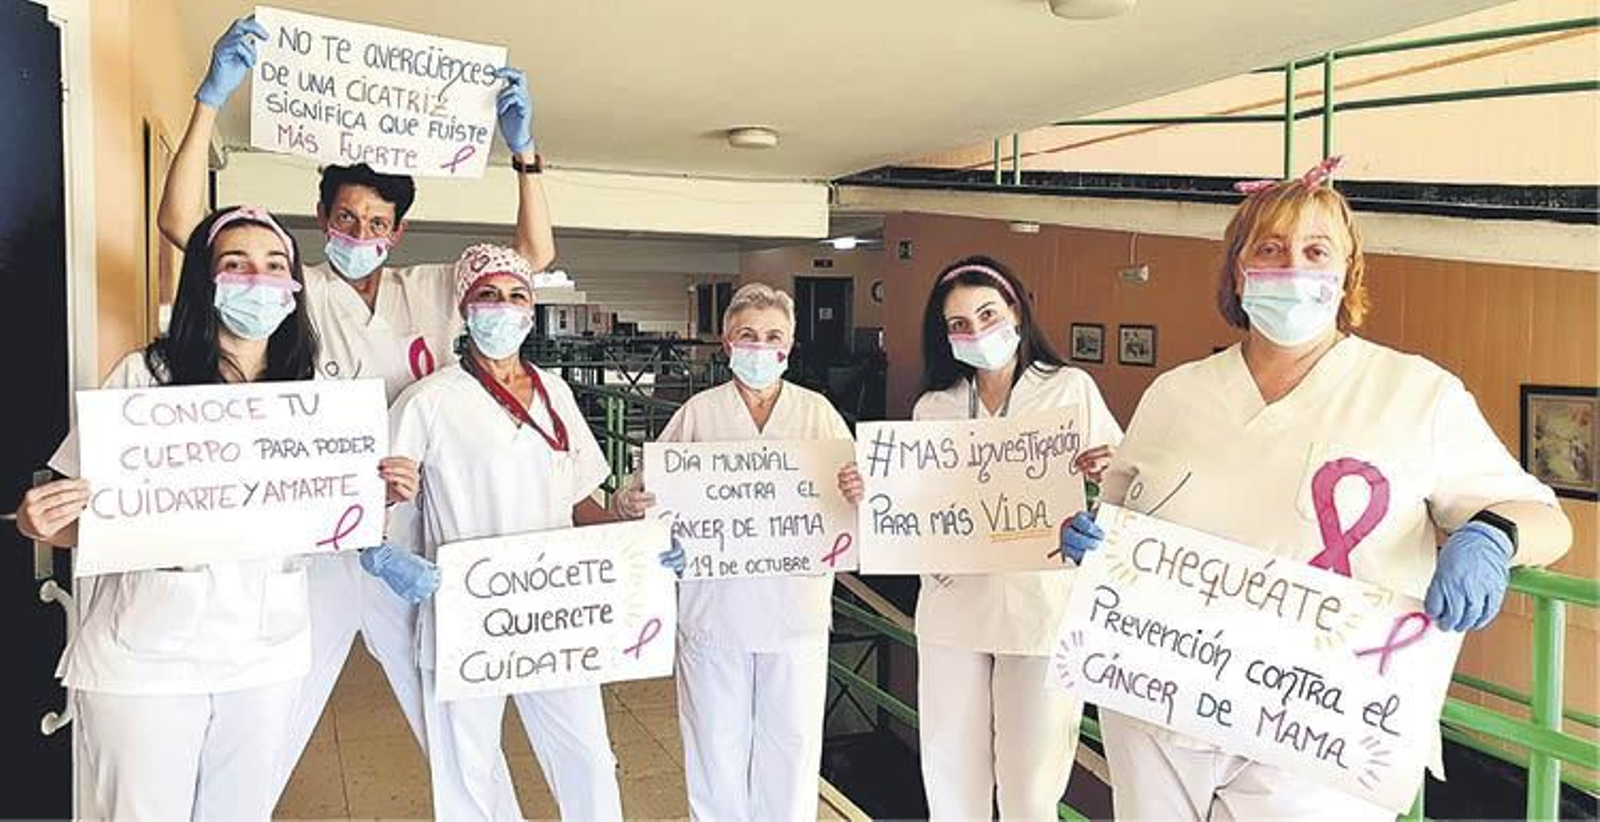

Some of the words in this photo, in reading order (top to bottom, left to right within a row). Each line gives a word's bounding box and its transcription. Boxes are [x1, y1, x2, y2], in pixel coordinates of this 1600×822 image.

[278, 26, 312, 55] NO
[298, 71, 336, 98] UNA
[122, 393, 266, 426] CONOCE
[278, 393, 320, 416] TU
[119, 440, 241, 470] CUERPO
[254, 438, 309, 460] PARA
[313, 435, 375, 456] PODER
[867, 429, 959, 477] #MAS
[242, 481, 259, 506] Y
[263, 474, 359, 503] AMARTE
[706, 482, 775, 500] CONTRA
[797, 480, 820, 497] EL
[659, 510, 725, 552] ÁNCER
[733, 518, 758, 539] DE
[769, 513, 825, 536] MAMA
[868, 493, 920, 536] PARA
[690, 554, 714, 577] 19
[1256, 705, 1350, 770] MAMA
